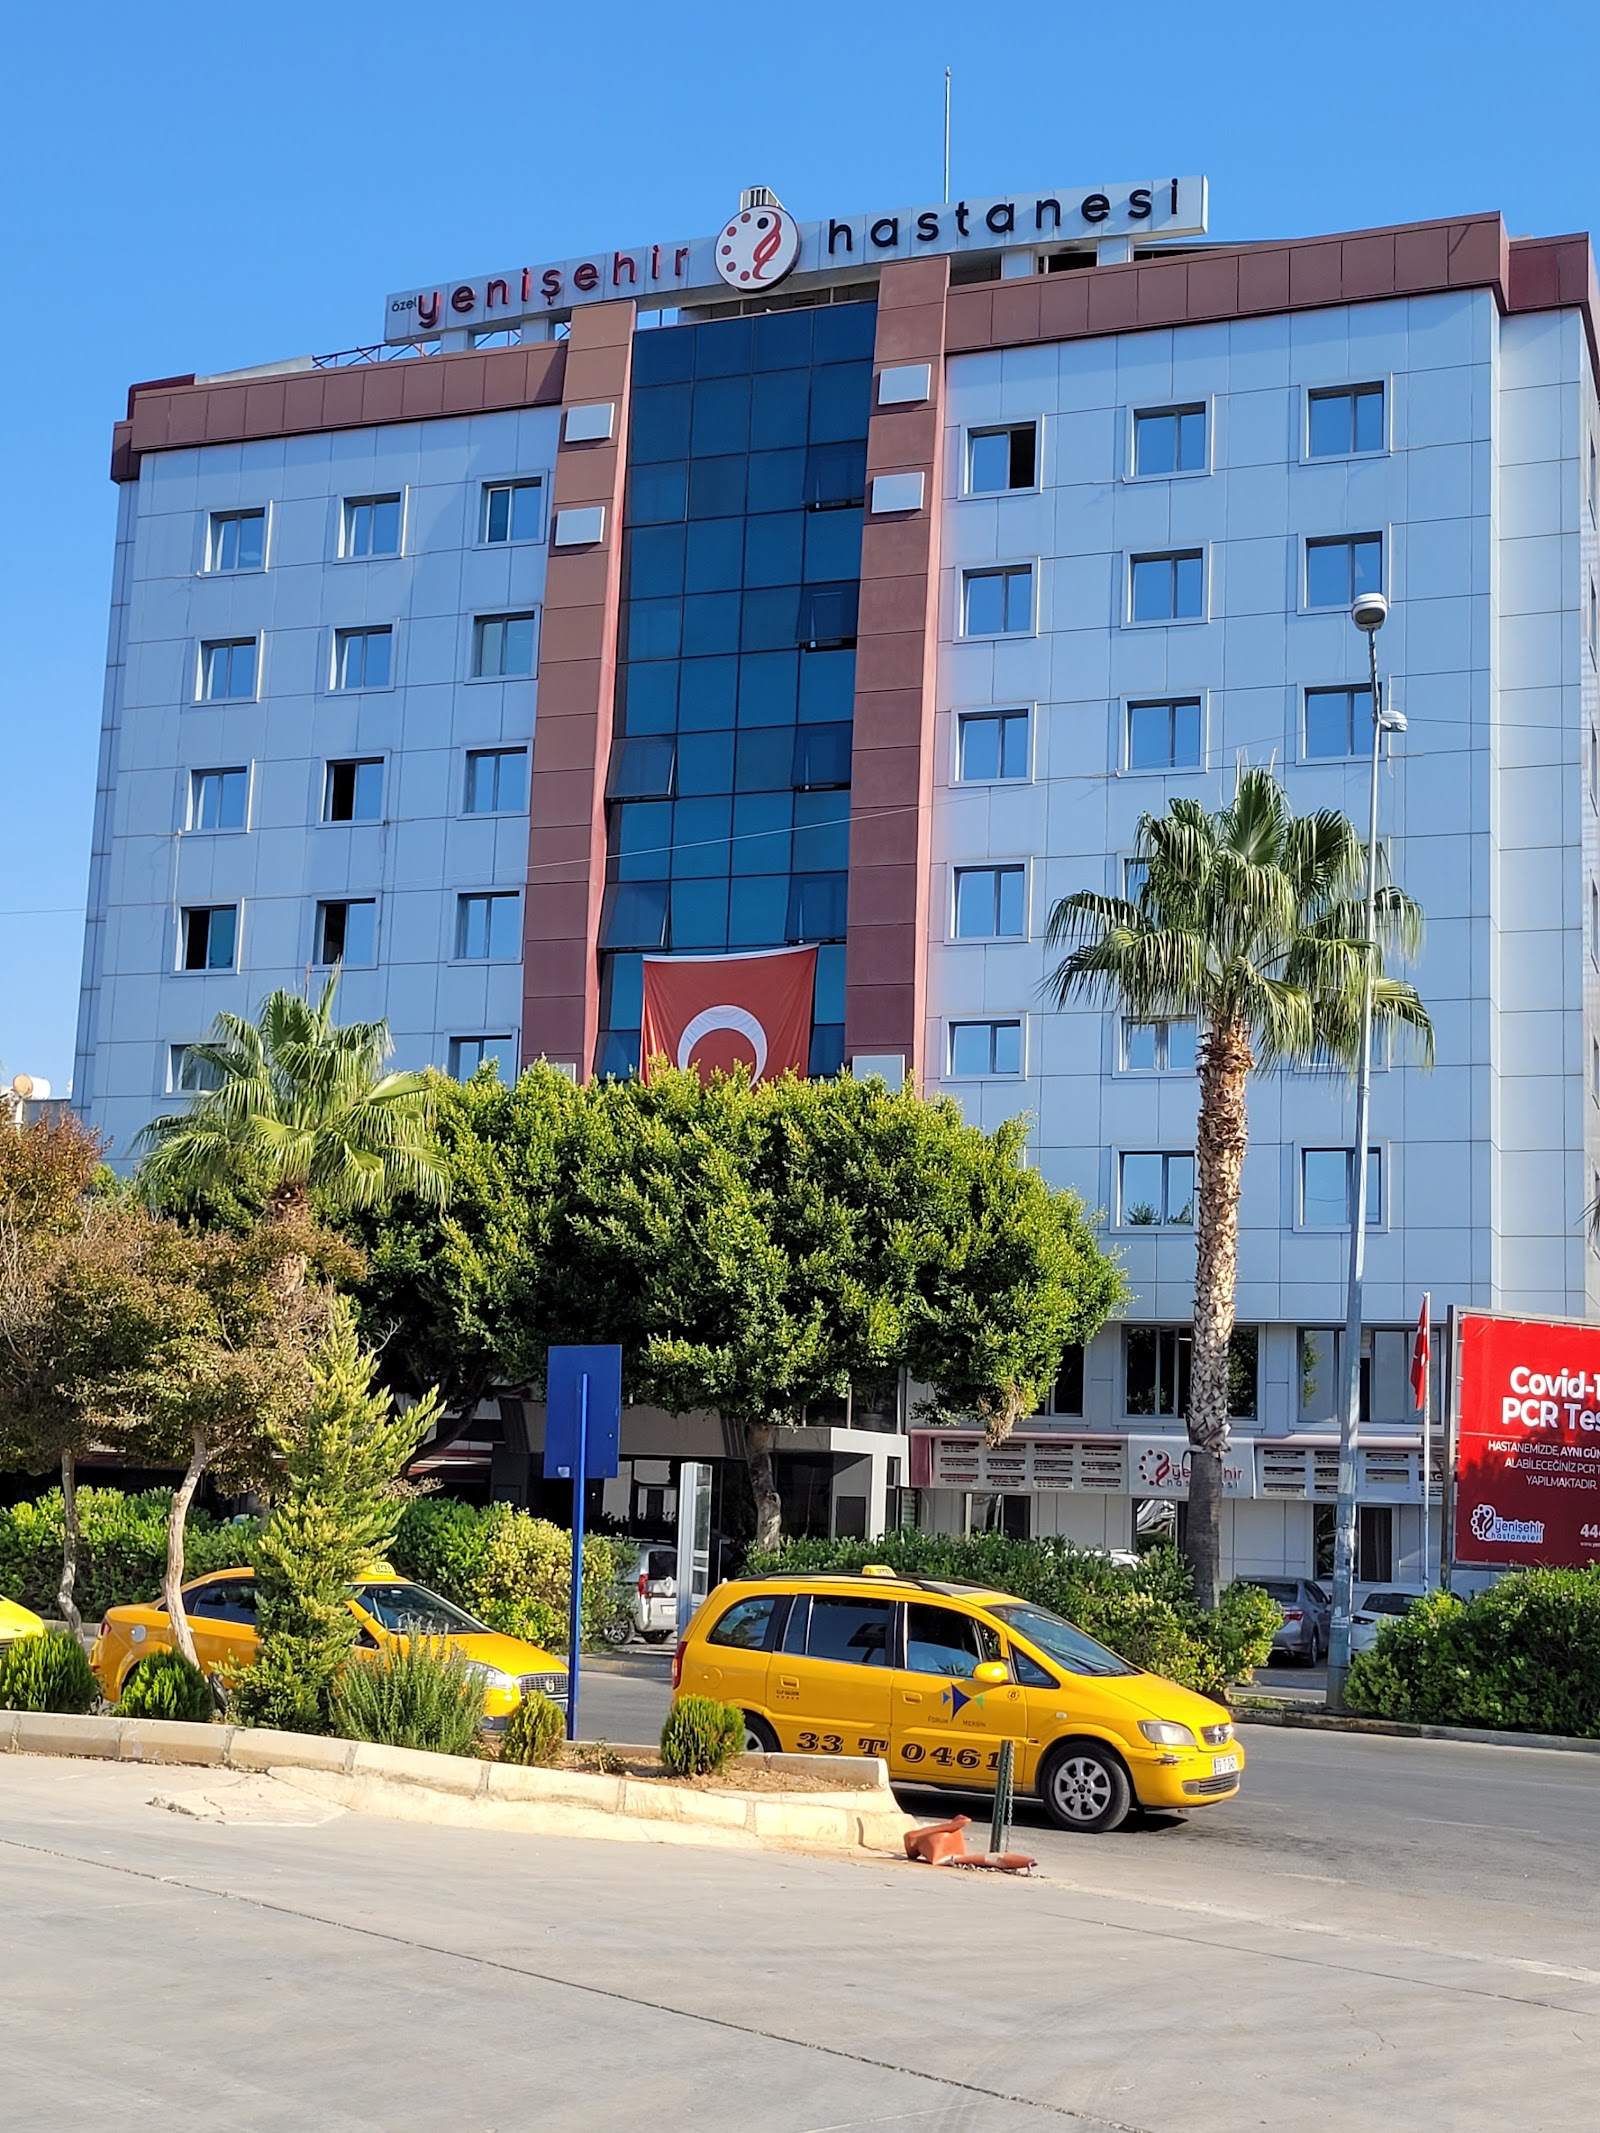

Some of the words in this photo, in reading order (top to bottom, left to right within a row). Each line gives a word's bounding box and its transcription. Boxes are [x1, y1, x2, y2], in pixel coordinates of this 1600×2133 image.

[391, 296, 417, 312] özel
[418, 245, 689, 329] yenişehir
[828, 178, 1179, 254] hastanesi
[1502, 1397, 1558, 1428] PCR
[1505, 1457, 1576, 1473] ALABİLECEĞİNİZ
[1577, 1463, 1596, 1475] PCR
[1560, 1446, 1582, 1458] AYNI
[796, 1731, 844, 1753] 33
[858, 1738, 889, 1758] T
[901, 1743, 1000, 1771] 0461
